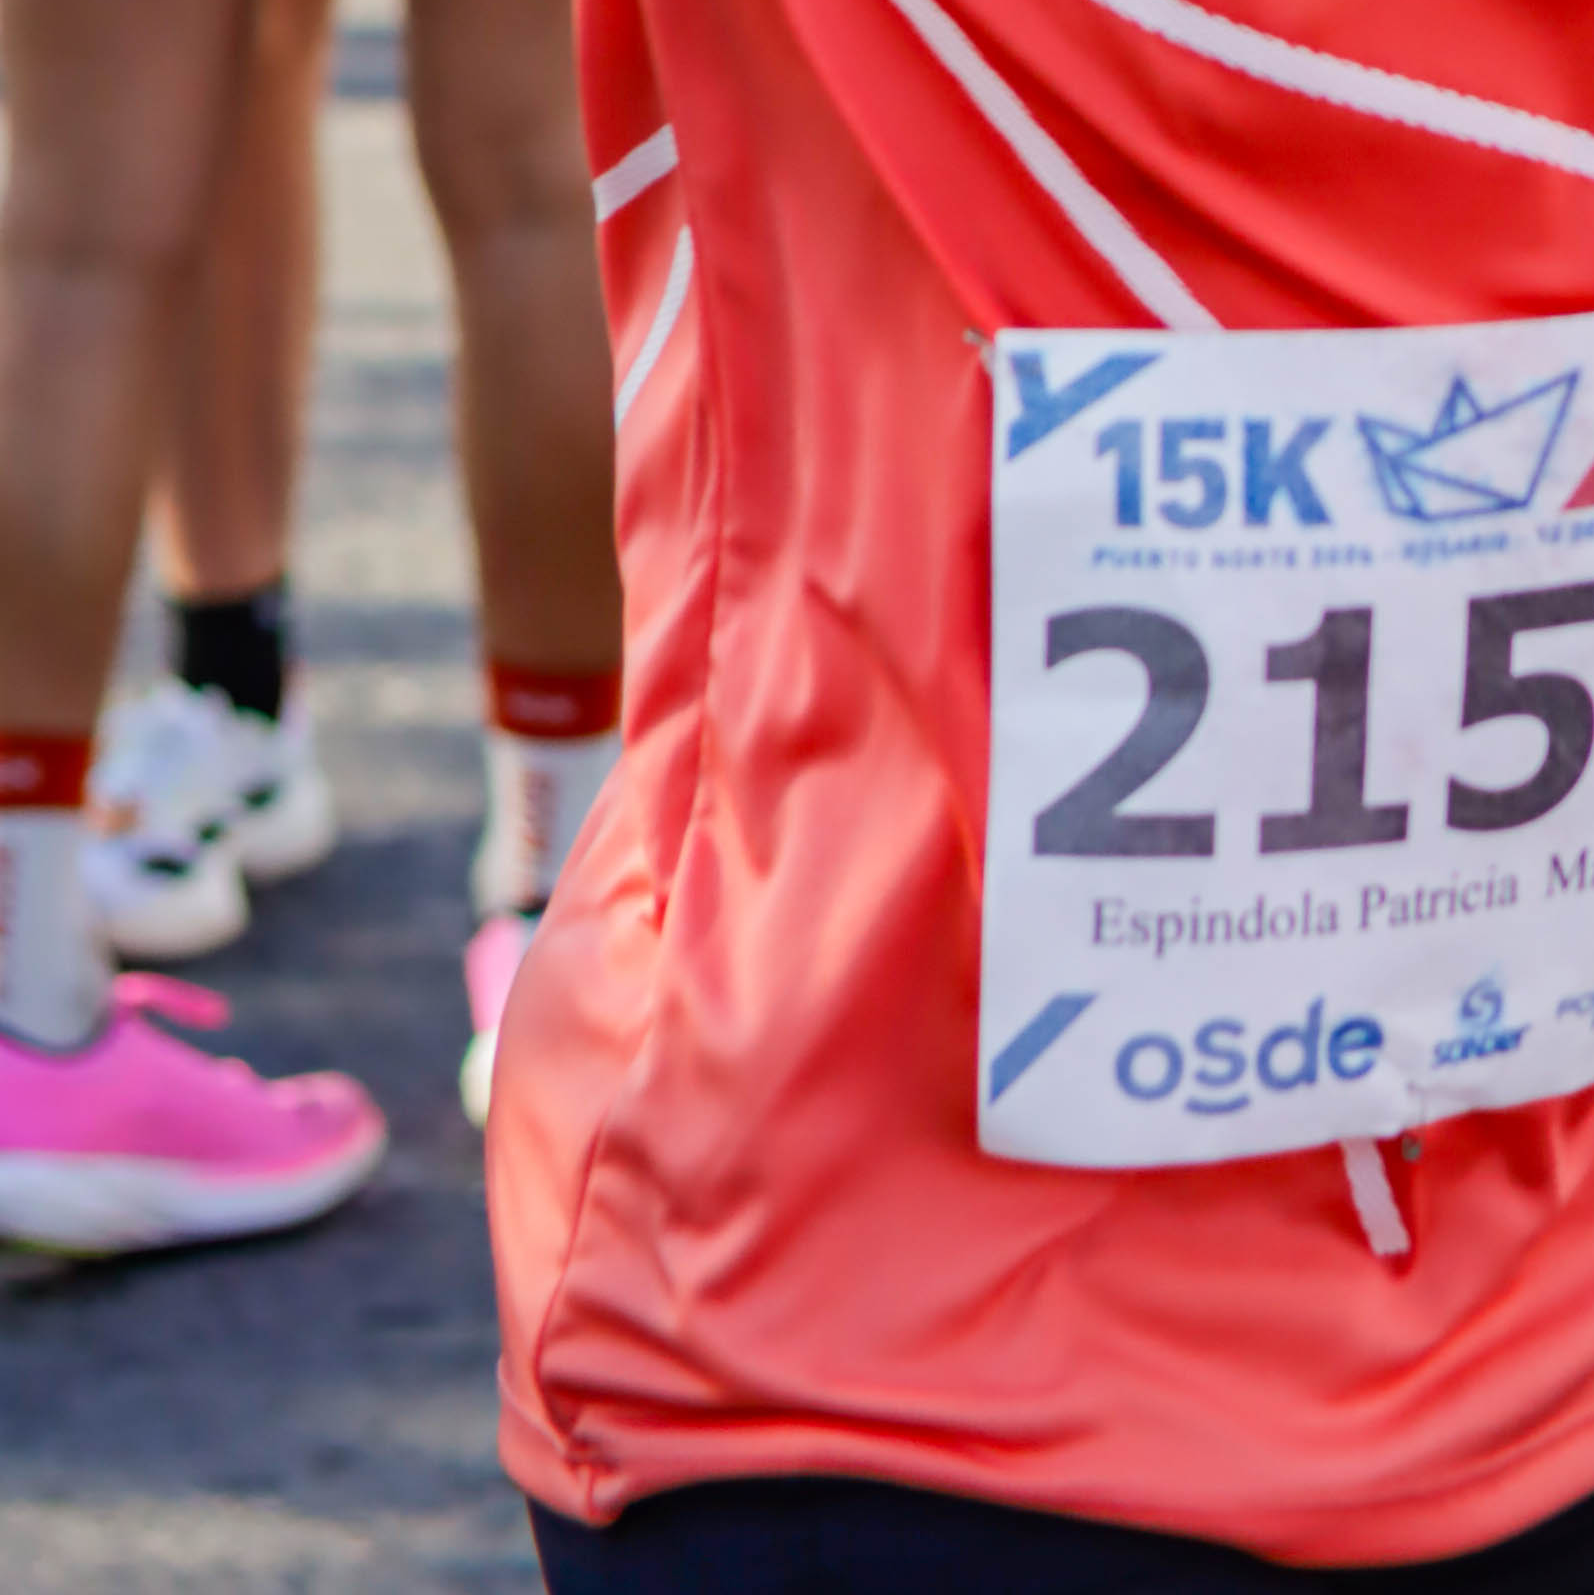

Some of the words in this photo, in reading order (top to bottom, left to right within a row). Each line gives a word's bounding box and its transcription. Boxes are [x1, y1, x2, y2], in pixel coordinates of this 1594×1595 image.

[1092, 415, 1333, 529] 15K
[1090, 893, 1341, 958] Espindola
[1357, 871, 1519, 932] Patricia
[1113, 997, 1385, 1115] osde
